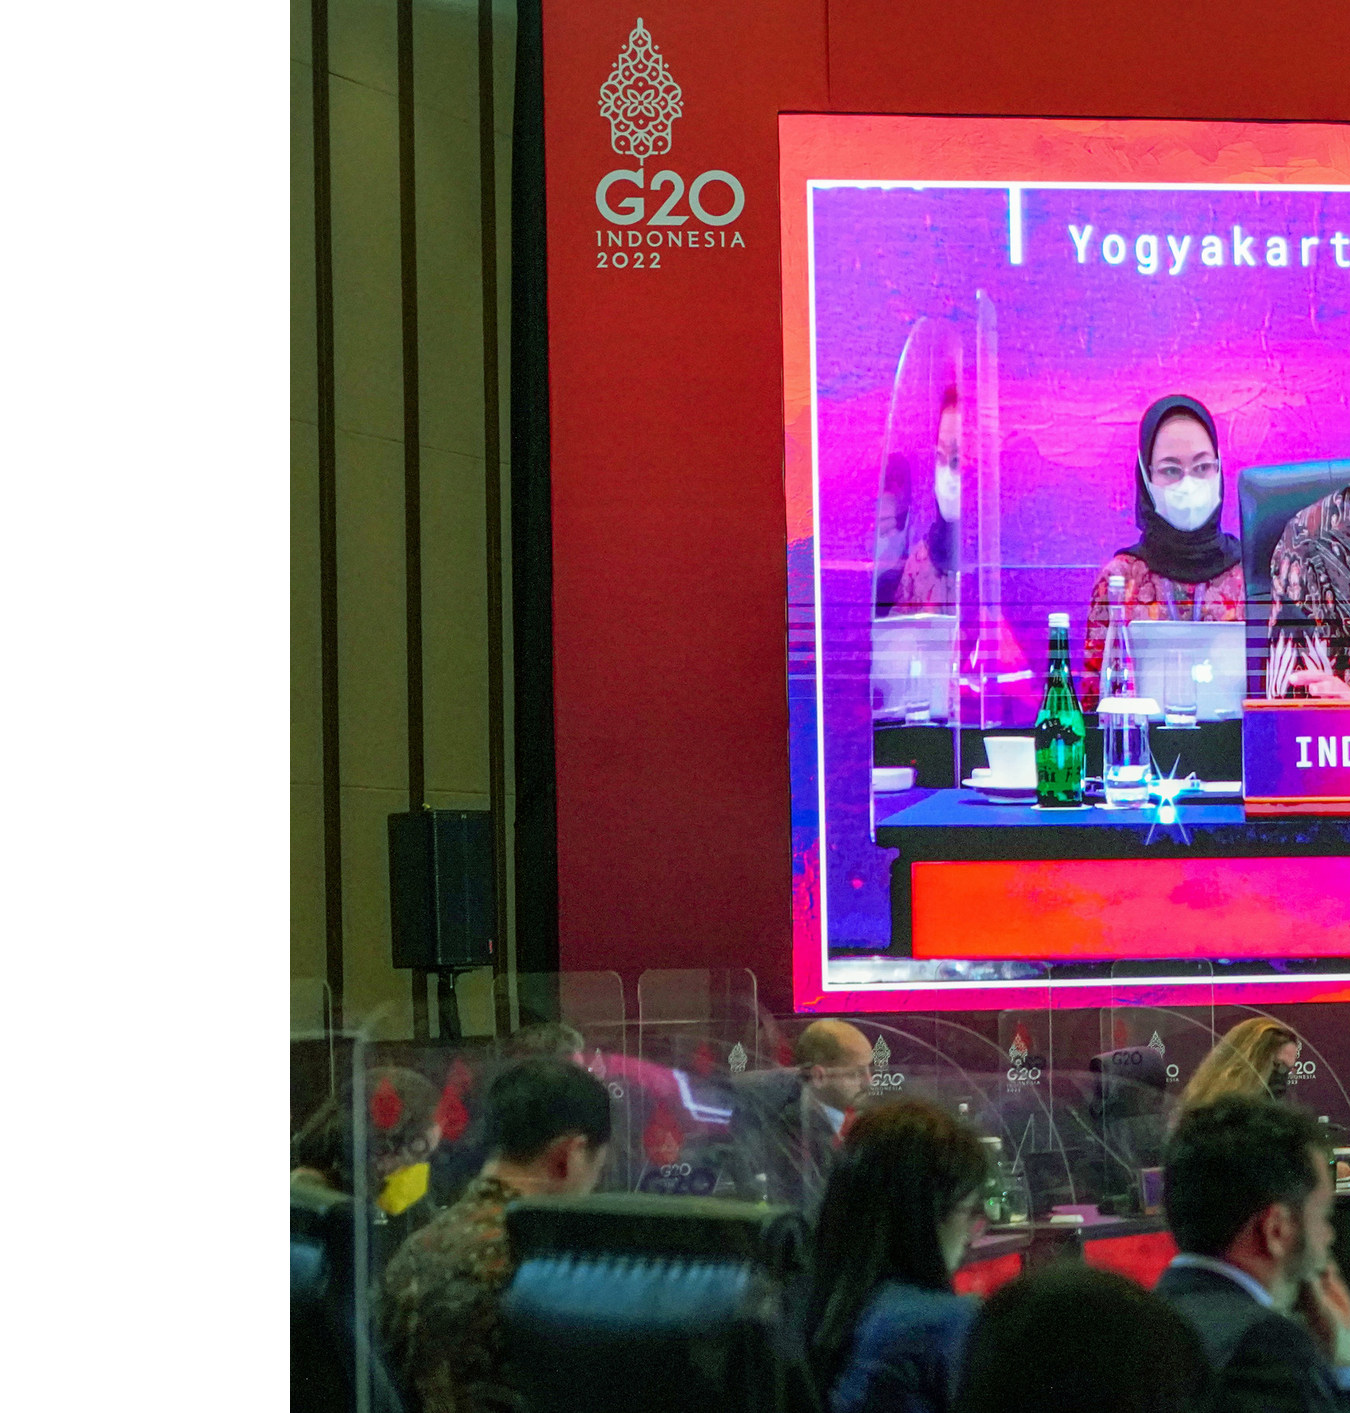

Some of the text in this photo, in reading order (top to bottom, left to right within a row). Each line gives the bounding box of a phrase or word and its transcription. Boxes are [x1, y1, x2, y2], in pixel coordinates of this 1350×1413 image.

[595, 168, 745, 226] G20
[596, 231, 746, 248] INDONESIA
[596, 252, 661, 268] 2022
[1007, 1067, 1041, 1081] G20
[1293, 1061, 1316, 1075] 20
[870, 1072, 905, 1086] G20
